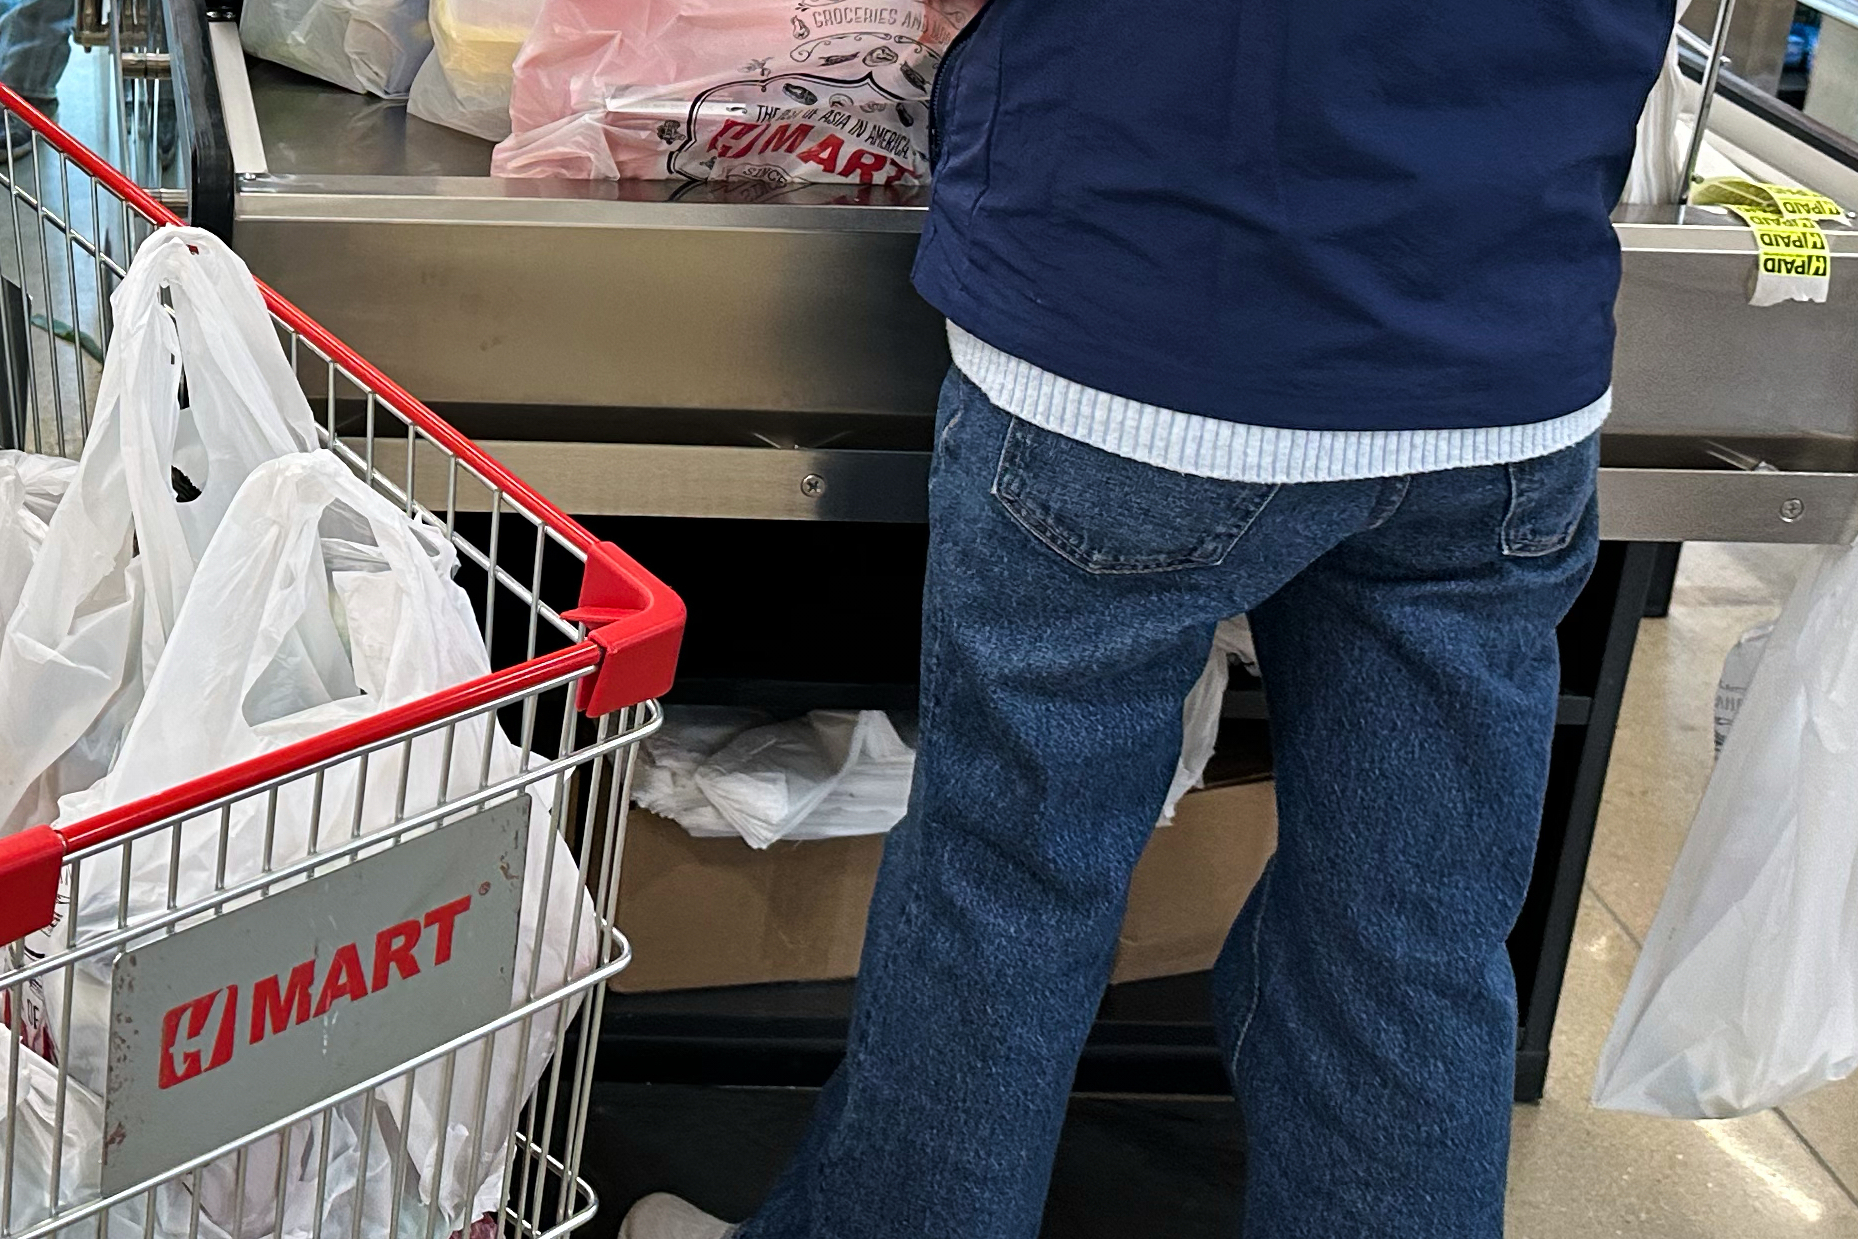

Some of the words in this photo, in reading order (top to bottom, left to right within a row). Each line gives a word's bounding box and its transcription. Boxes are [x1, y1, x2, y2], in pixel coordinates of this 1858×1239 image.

[812, 6, 898, 28] GROCERIES
[901, 11, 929, 34] AND
[757, 104, 778, 123] THE
[818, 109, 851, 129] ASIA
[848, 118, 869, 138] IN
[757, 122, 923, 186] MART
[743, 164, 788, 187] SINCE
[1760, 233, 1804, 249] PAID
[1763, 257, 1806, 275] PAID
[249, 894, 472, 1046] MART
